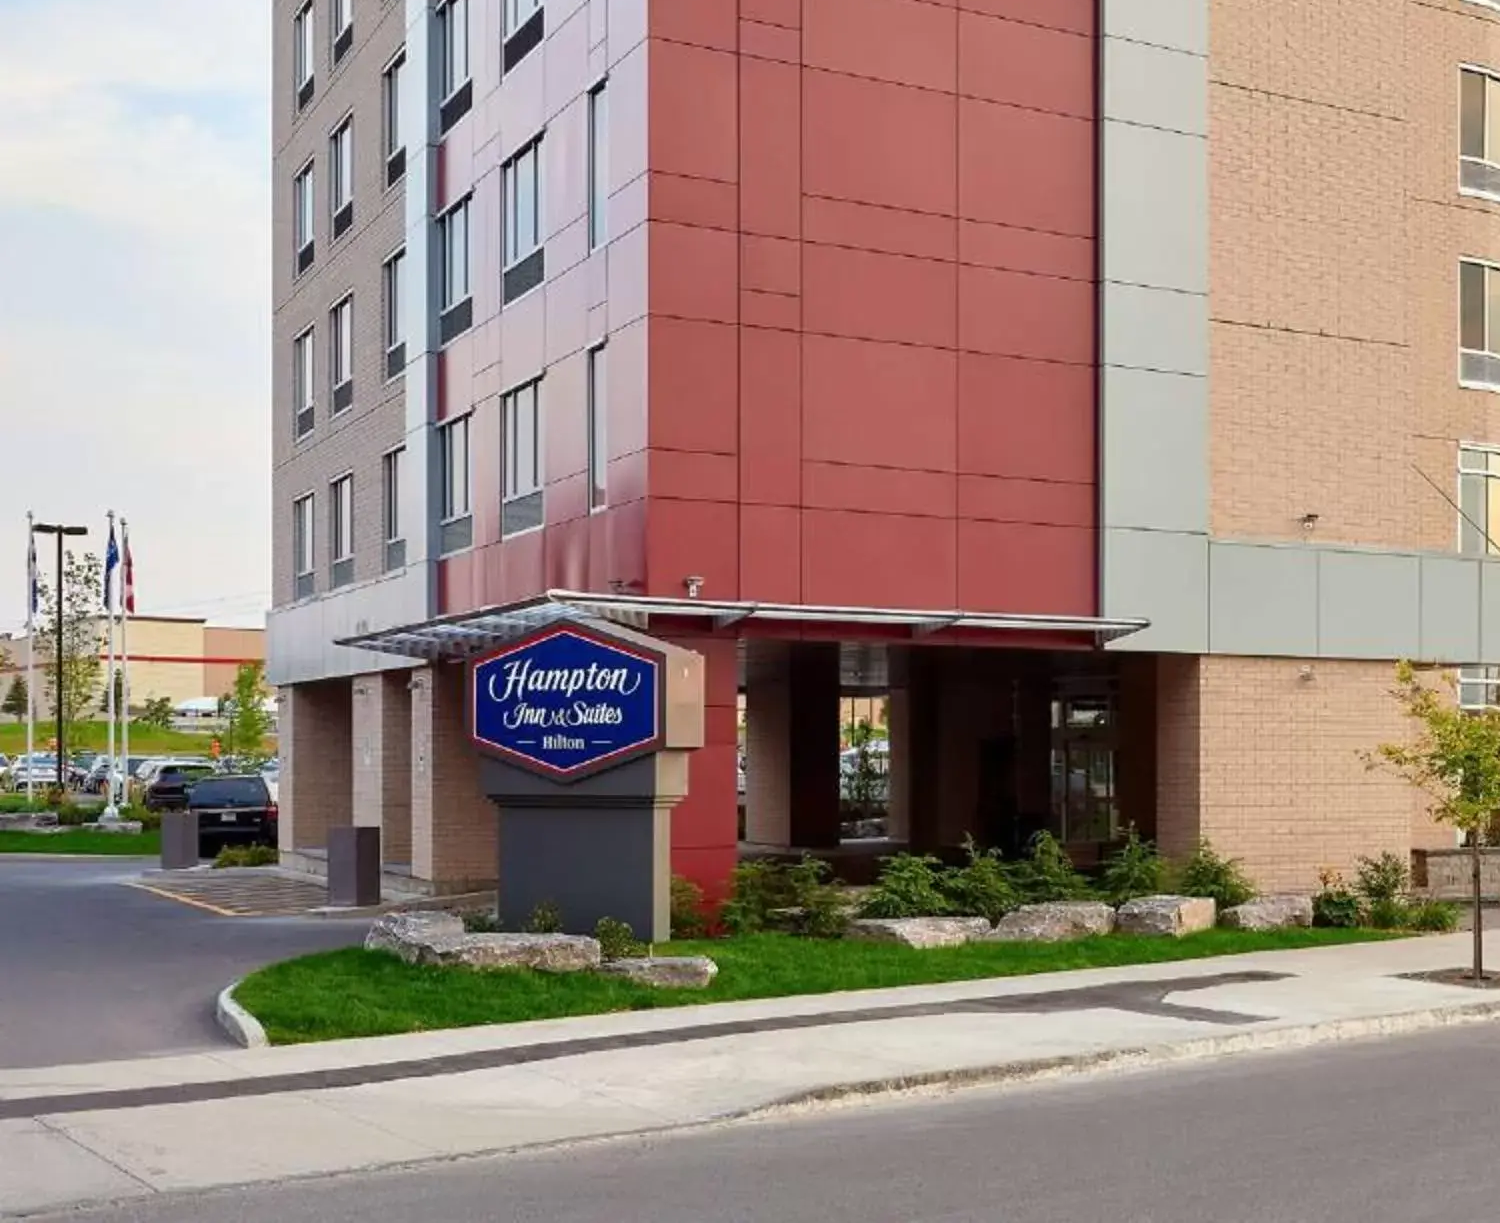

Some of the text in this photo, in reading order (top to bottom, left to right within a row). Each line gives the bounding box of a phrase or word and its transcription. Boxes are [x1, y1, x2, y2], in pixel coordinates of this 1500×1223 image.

[489, 658, 641, 702] Hampton
[503, 700, 623, 728] Inn & Suites
[543, 734, 585, 750] Hilton
